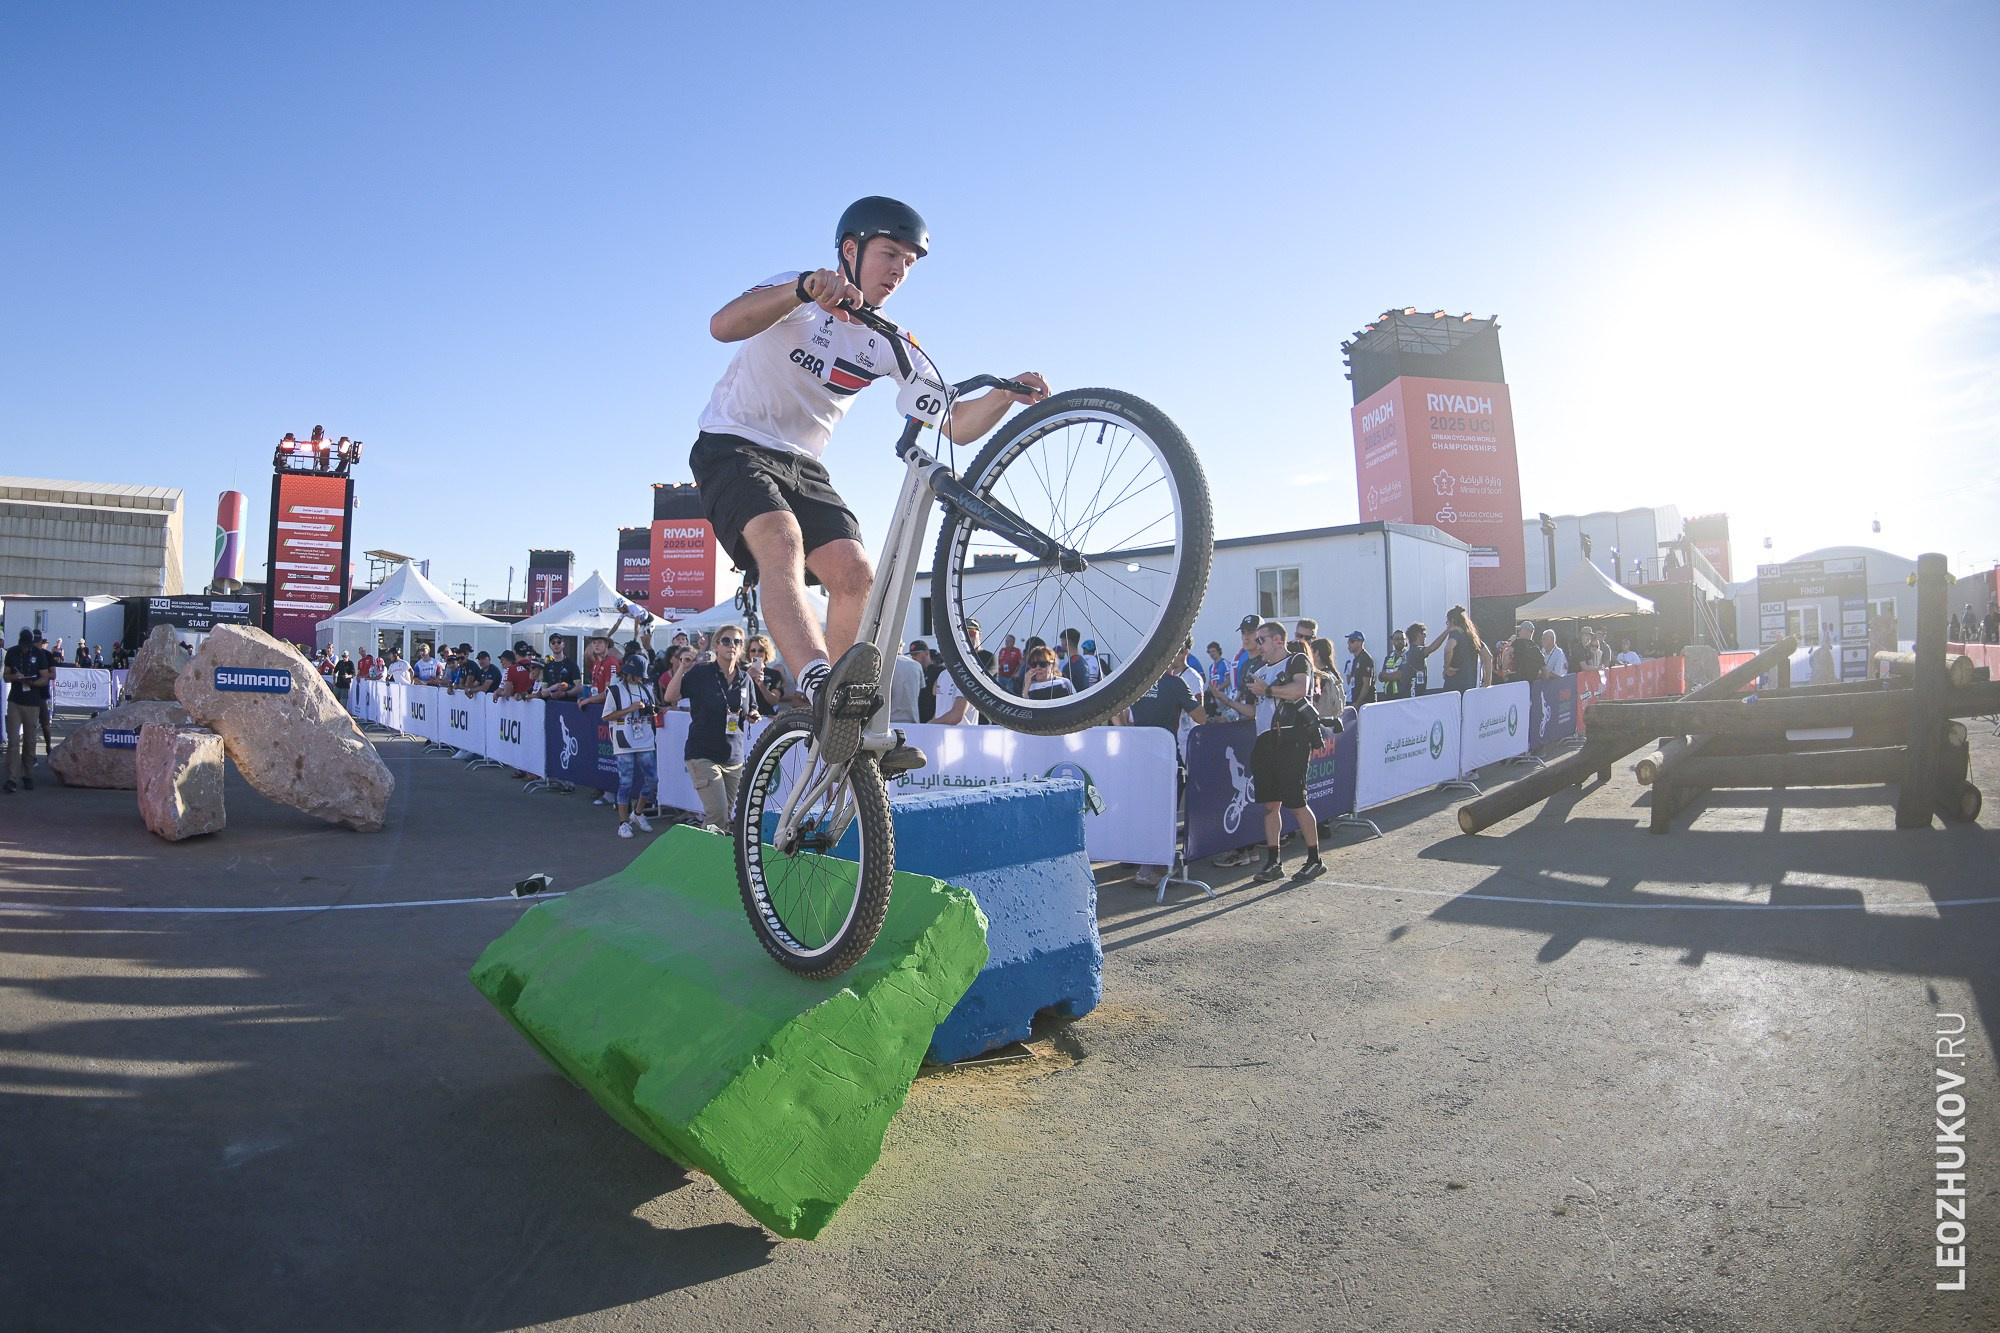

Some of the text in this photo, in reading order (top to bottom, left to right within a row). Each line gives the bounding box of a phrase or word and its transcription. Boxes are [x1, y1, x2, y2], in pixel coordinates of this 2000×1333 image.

[789, 348, 825, 379] GBR
[915, 394, 942, 416] 6D
[1426, 393, 1492, 415] RIYADH
[1361, 400, 1394, 433] RIYADH
[1429, 416, 1496, 433] 2025 UCI
[1431, 433, 1452, 441] URBAN
[1432, 442, 1497, 452] CHAMPIONSHIPS
[664, 528, 704, 538] RIYADH
[663, 540, 704, 548] 2025 UCI
[1762, 567, 1779, 576] UCI
[1800, 586, 1825, 595] FINISH
[153, 600, 169, 609] UCI
[1765, 603, 1782, 612] UCI
[216, 673, 290, 688] SHIMANO
[952, 661, 997, 708] NATIONAL
[413, 702, 426, 722] UCI
[997, 703, 1020, 718] THE
[453, 709, 468, 731] UCI
[503, 719, 521, 745] UCI
[1319, 760, 1335, 777] UCI
[1308, 787, 1334, 801] PIONSHIPS
